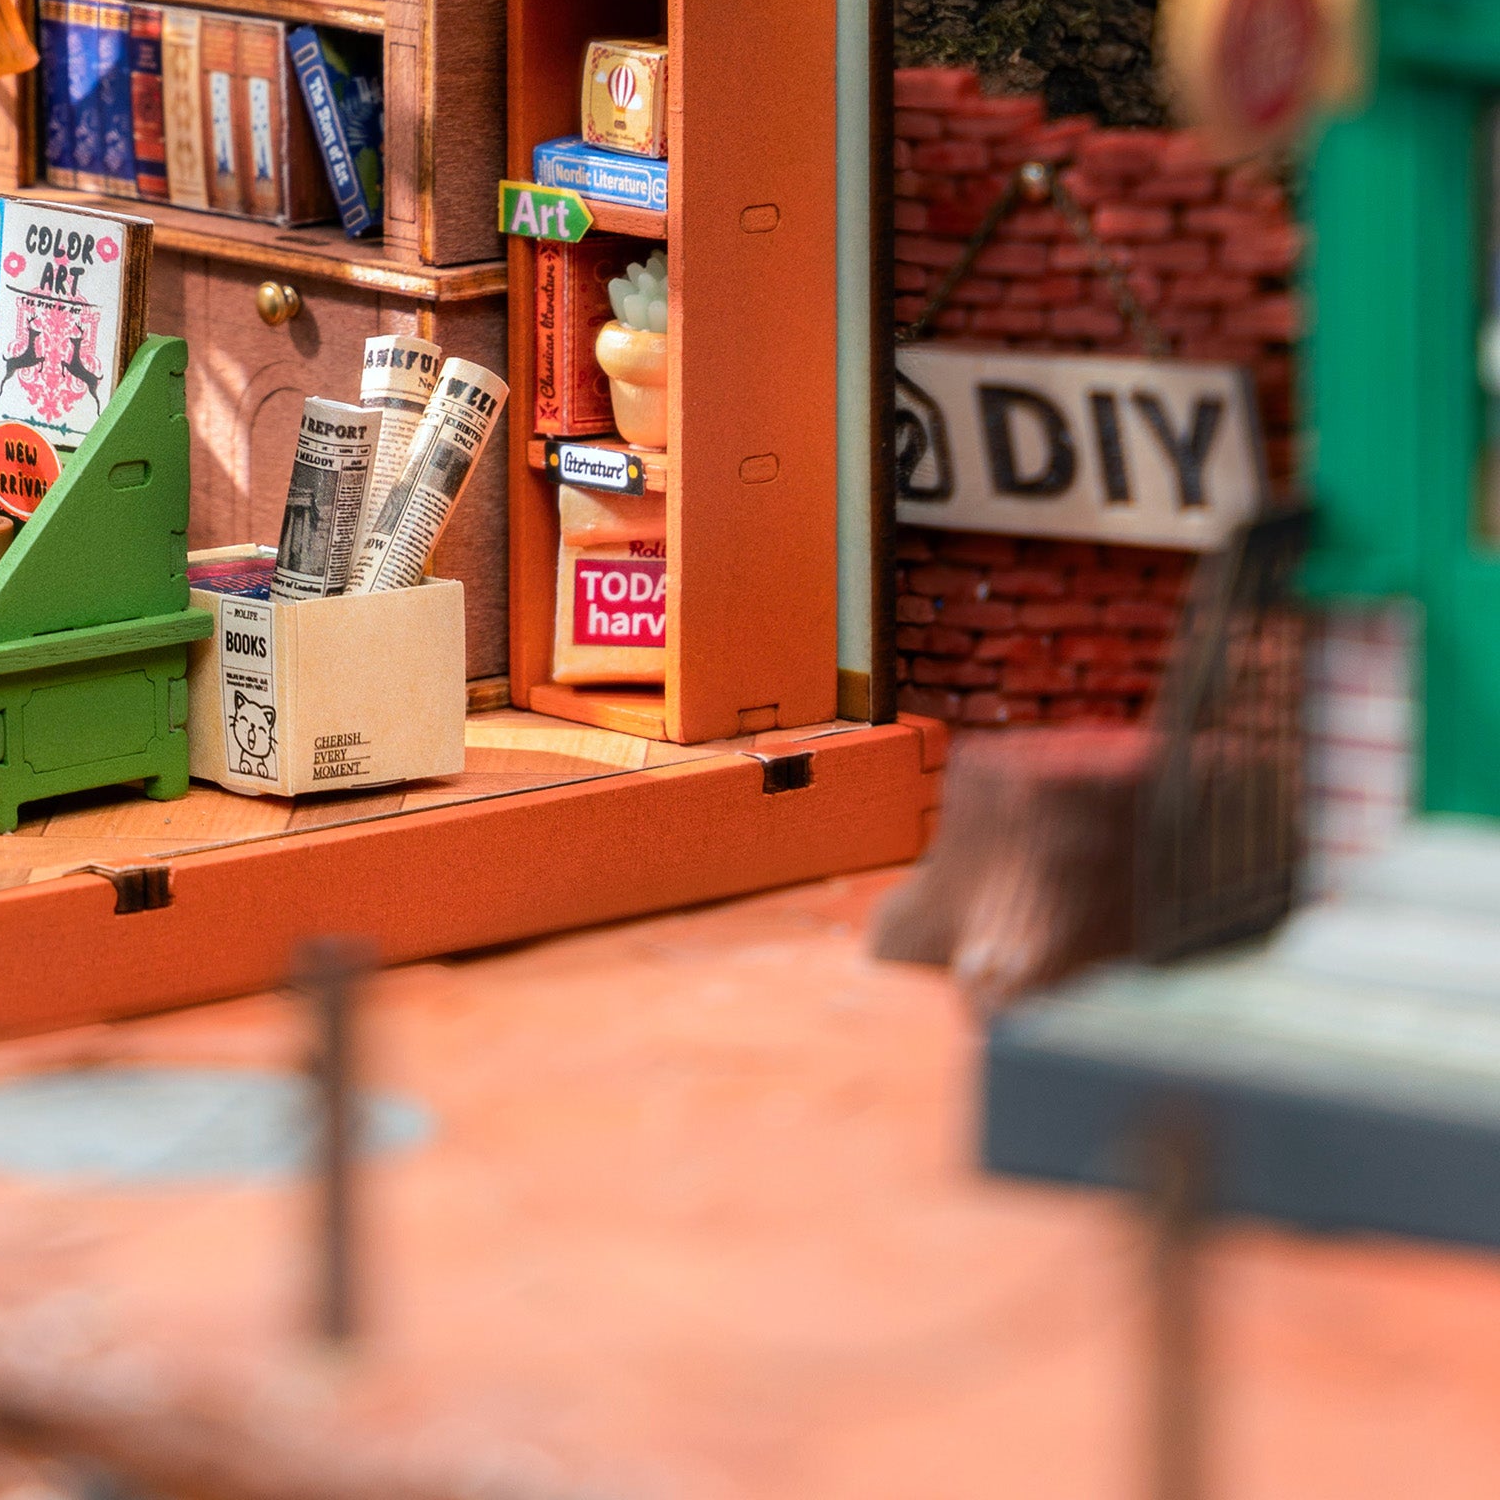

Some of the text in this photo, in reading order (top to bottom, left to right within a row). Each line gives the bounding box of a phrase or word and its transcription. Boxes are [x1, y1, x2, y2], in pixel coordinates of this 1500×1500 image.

[308, 74, 326, 108] The
[555, 163, 648, 195] Nordic Literature
[510, 190, 570, 238] Art
[25, 224, 95, 265] COLOR
[40, 262, 85, 297] ART
[308, 417, 367, 440] REPORT
[5, 440, 37, 467] NEW
[300, 450, 335, 468] MELODY
[977, 383, 1225, 510] DIY
[629, 540, 666, 558] Roli
[580, 570, 666, 602] TODA
[588, 603, 666, 636] harv
[225, 629, 267, 659] BOOKS
[314, 731, 361, 750] CHERISH
[313, 748, 347, 765] EVERY
[313, 761, 361, 780] MOMENT
